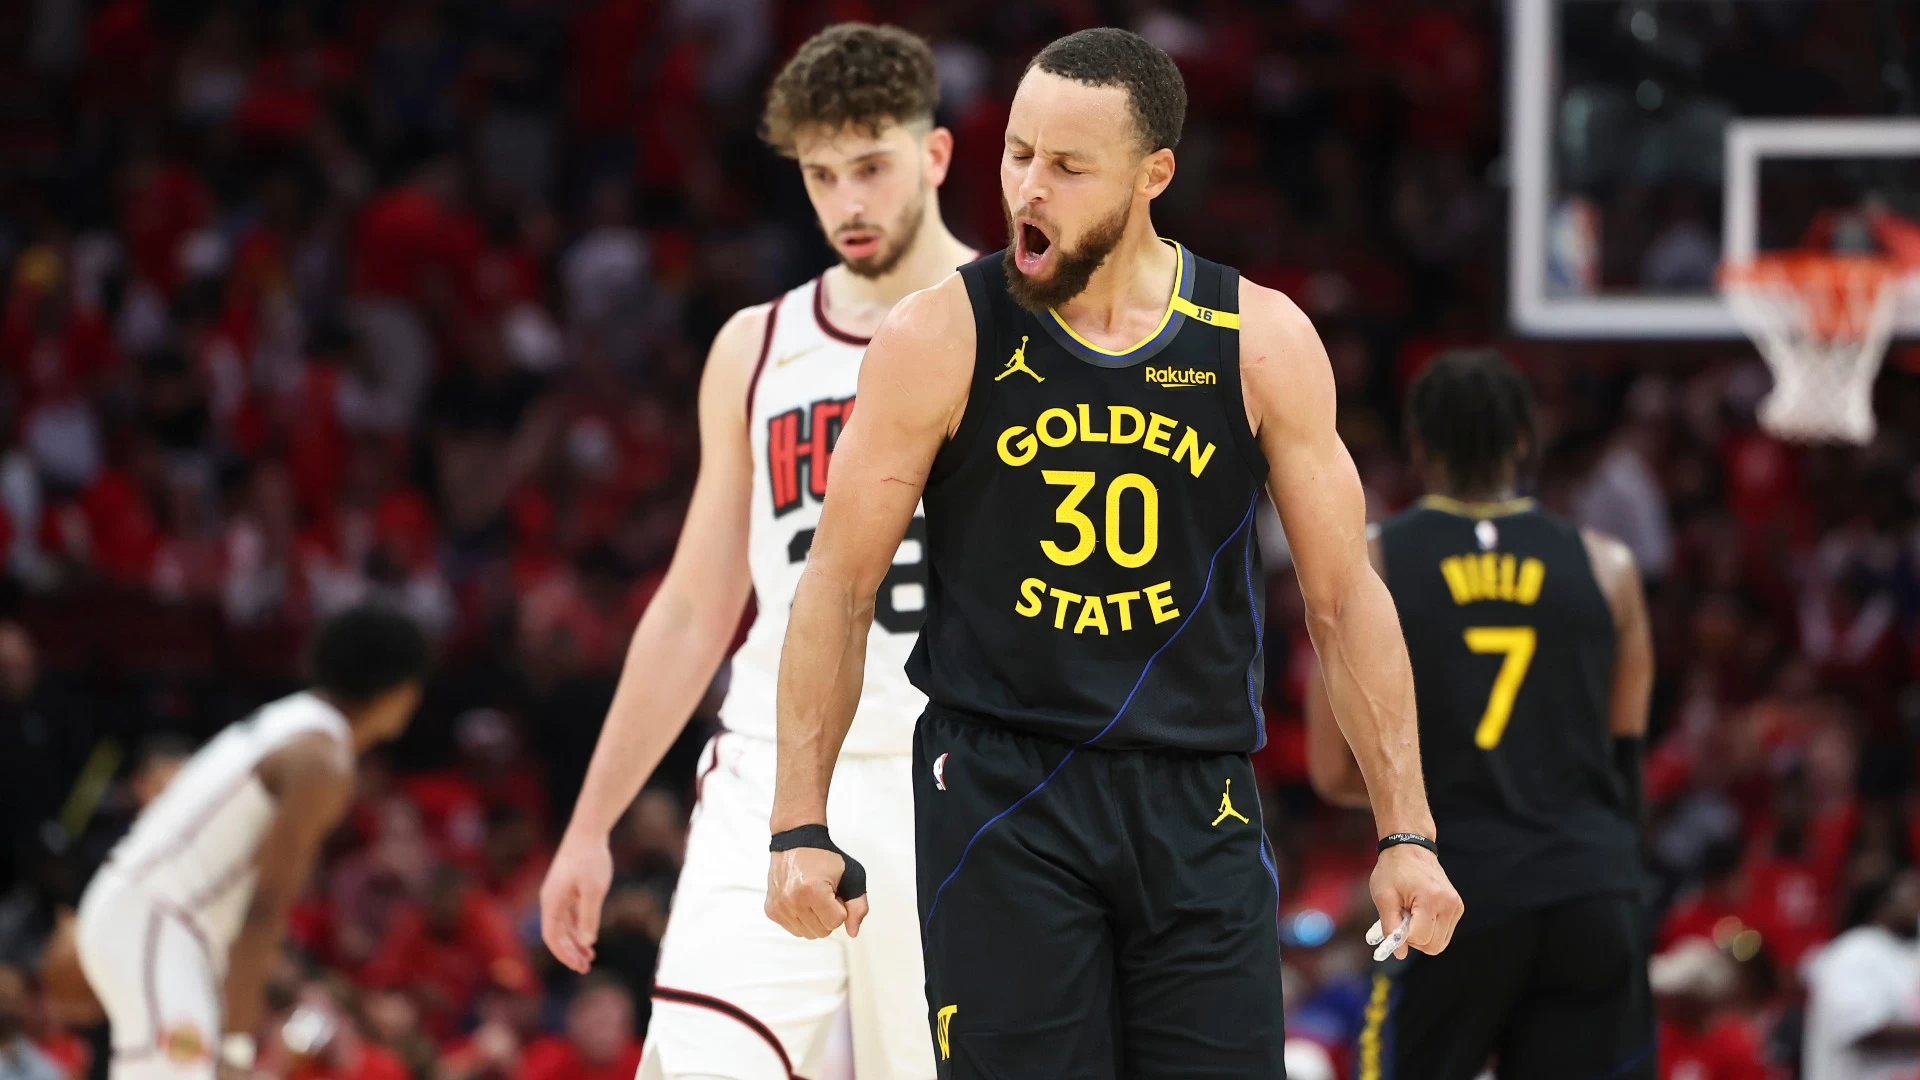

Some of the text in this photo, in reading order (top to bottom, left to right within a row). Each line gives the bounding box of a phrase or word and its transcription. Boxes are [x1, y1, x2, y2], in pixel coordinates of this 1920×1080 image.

[1196, 308, 1213, 322] 16
[1145, 366, 1217, 386] Rakuten
[996, 403, 1217, 479] GOLDEN
[1039, 469, 1160, 569] 30
[1015, 577, 1181, 636] STATE
[1462, 626, 1537, 750] 7
